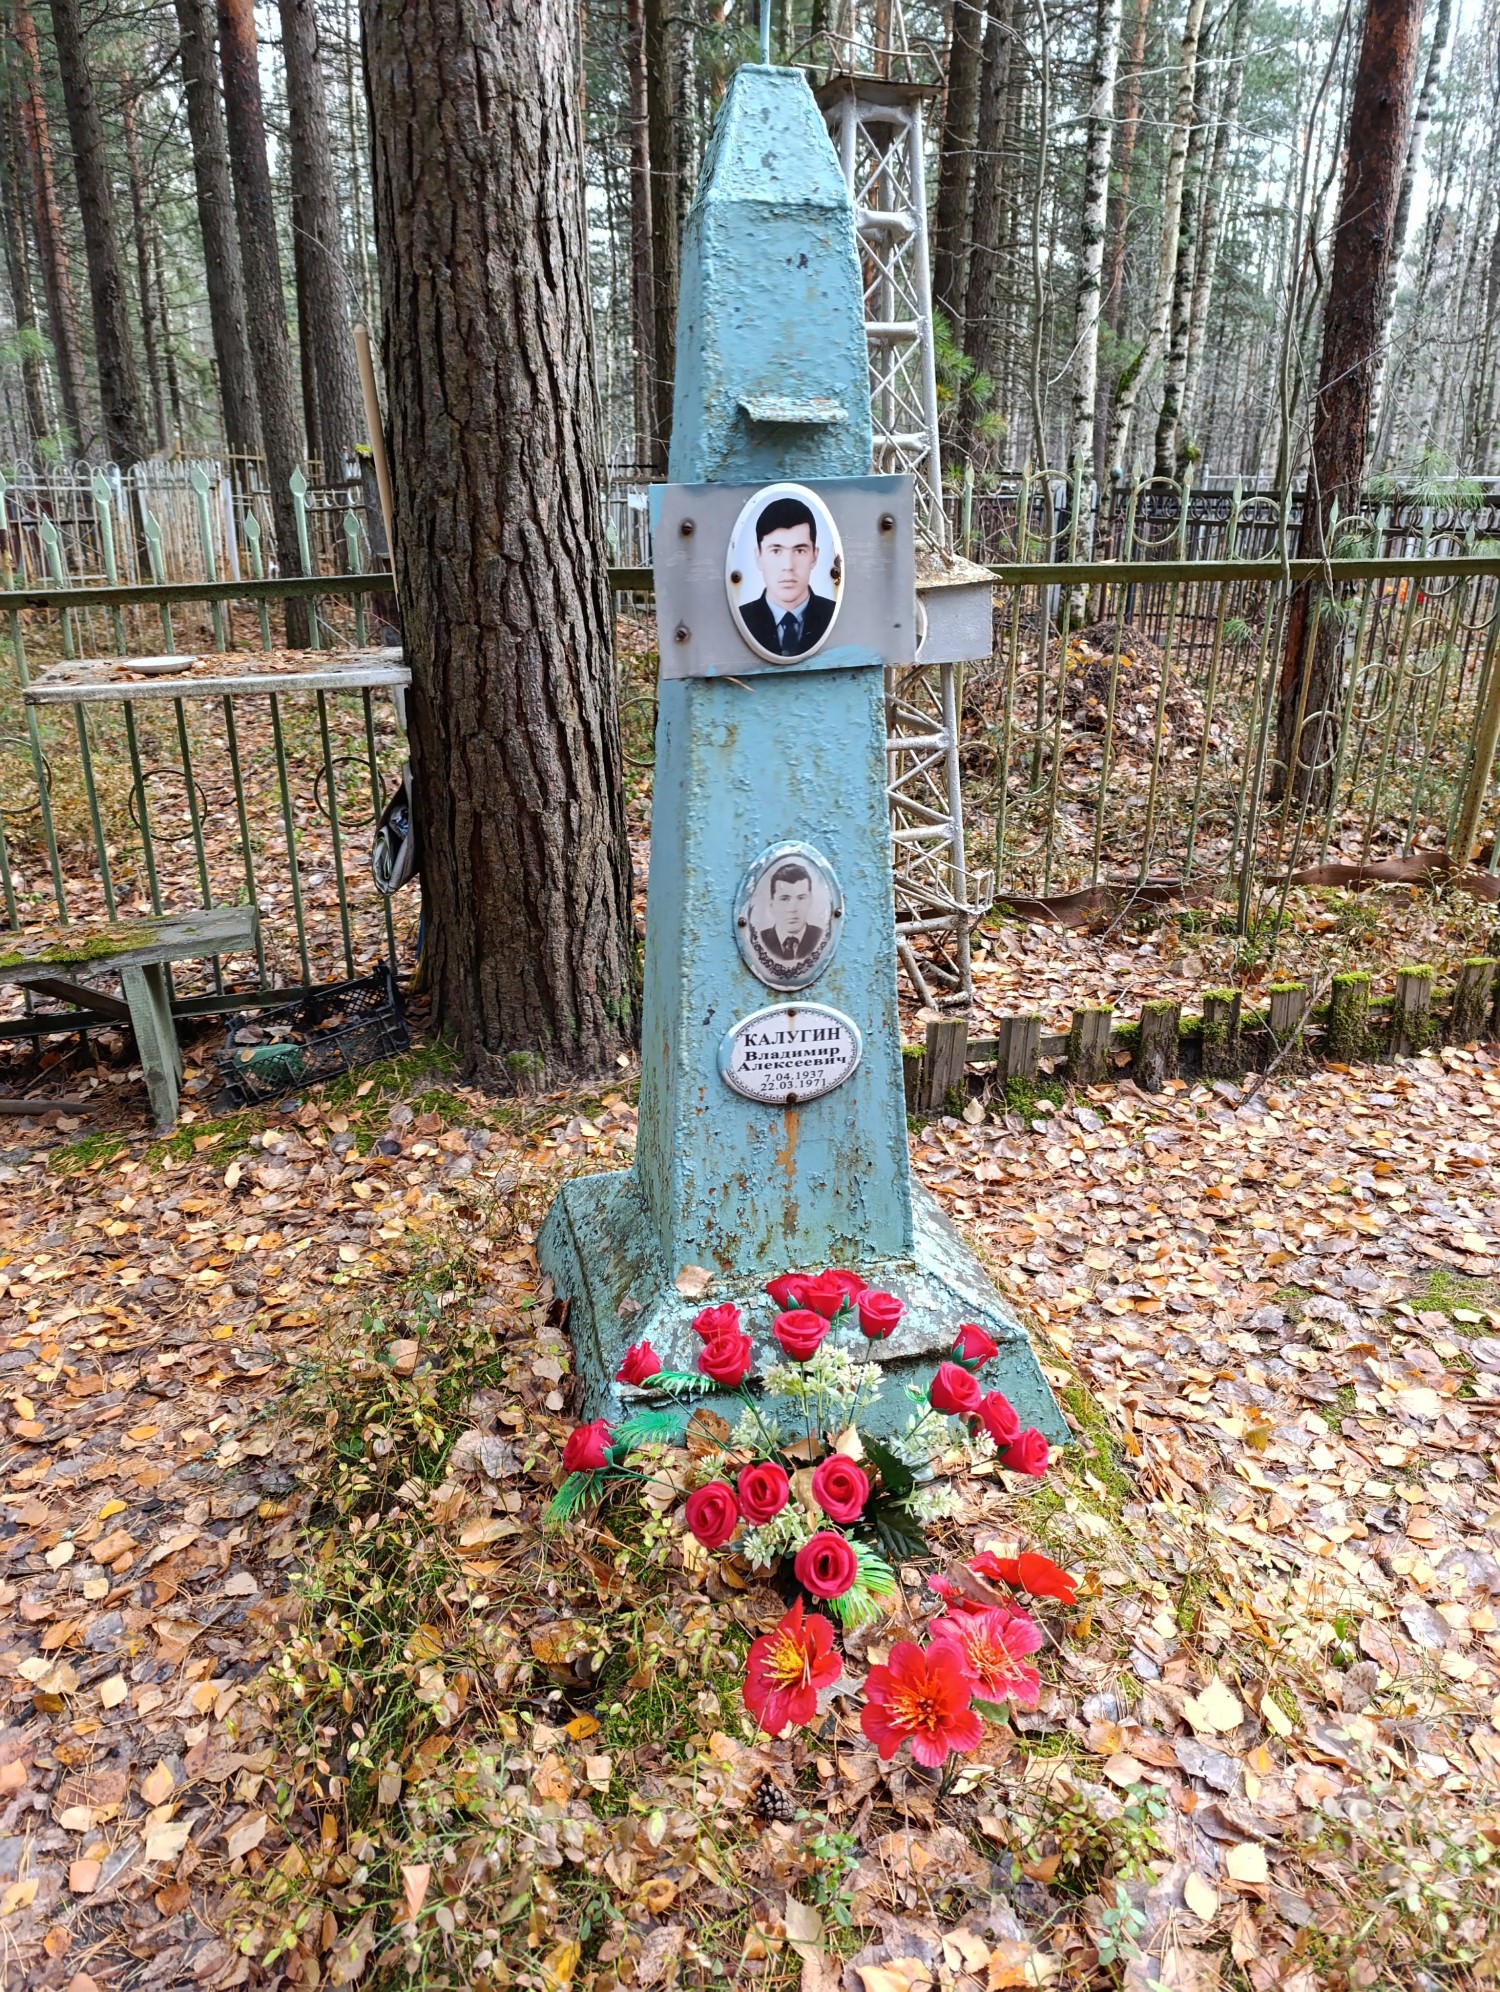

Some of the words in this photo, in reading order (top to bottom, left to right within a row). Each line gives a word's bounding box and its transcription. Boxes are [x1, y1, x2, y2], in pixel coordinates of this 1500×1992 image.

[744, 1027, 840, 1047] КАЛУГИН
[745, 1047, 840, 1061] Владимир
[737, 1057, 846, 1072] Алексеевич
[764, 1070, 824, 1082] 7.04.1937
[761, 1079, 826, 1091] 22.03.1971
